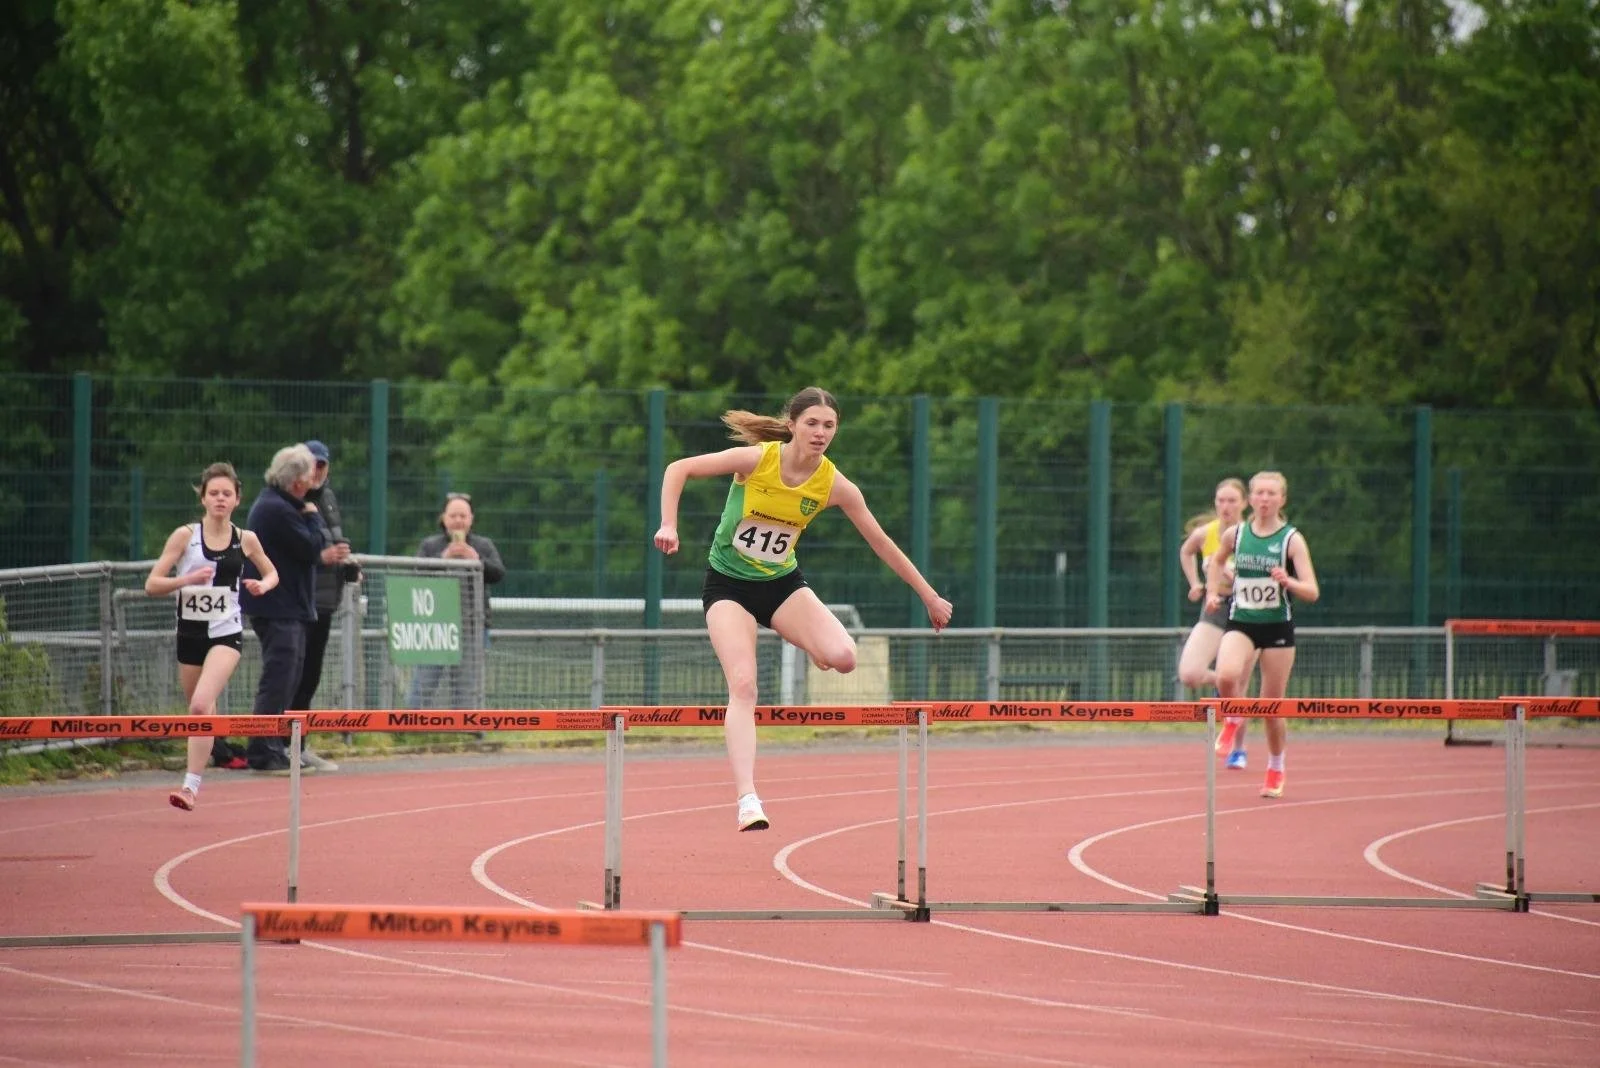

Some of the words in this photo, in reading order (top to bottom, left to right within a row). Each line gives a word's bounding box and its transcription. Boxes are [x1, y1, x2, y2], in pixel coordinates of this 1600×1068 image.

[739, 526, 791, 555] 415
[412, 588, 435, 617] NO
[1241, 586, 1276, 603] 102
[185, 594, 227, 614] 434
[391, 622, 460, 652] SMOKING
[628, 708, 682, 723] arshall
[698, 708, 763, 721] Miln
[771, 709, 846, 723] Keynes
[989, 704, 1052, 717] Milton
[1060, 704, 1134, 720] Keynes
[1297, 702, 1361, 715] Milton
[1368, 702, 1443, 718] Keynes
[1528, 700, 1581, 714] arshall
[0, 720, 34, 735] hall
[50, 719, 122, 733] Milton
[131, 719, 214, 736] Keynes
[388, 713, 455, 726] Milton
[463, 713, 541, 729] Keynes
[262, 909, 348, 933] Marshall
[368, 912, 453, 934] Milton
[463, 914, 562, 939] Keynes
